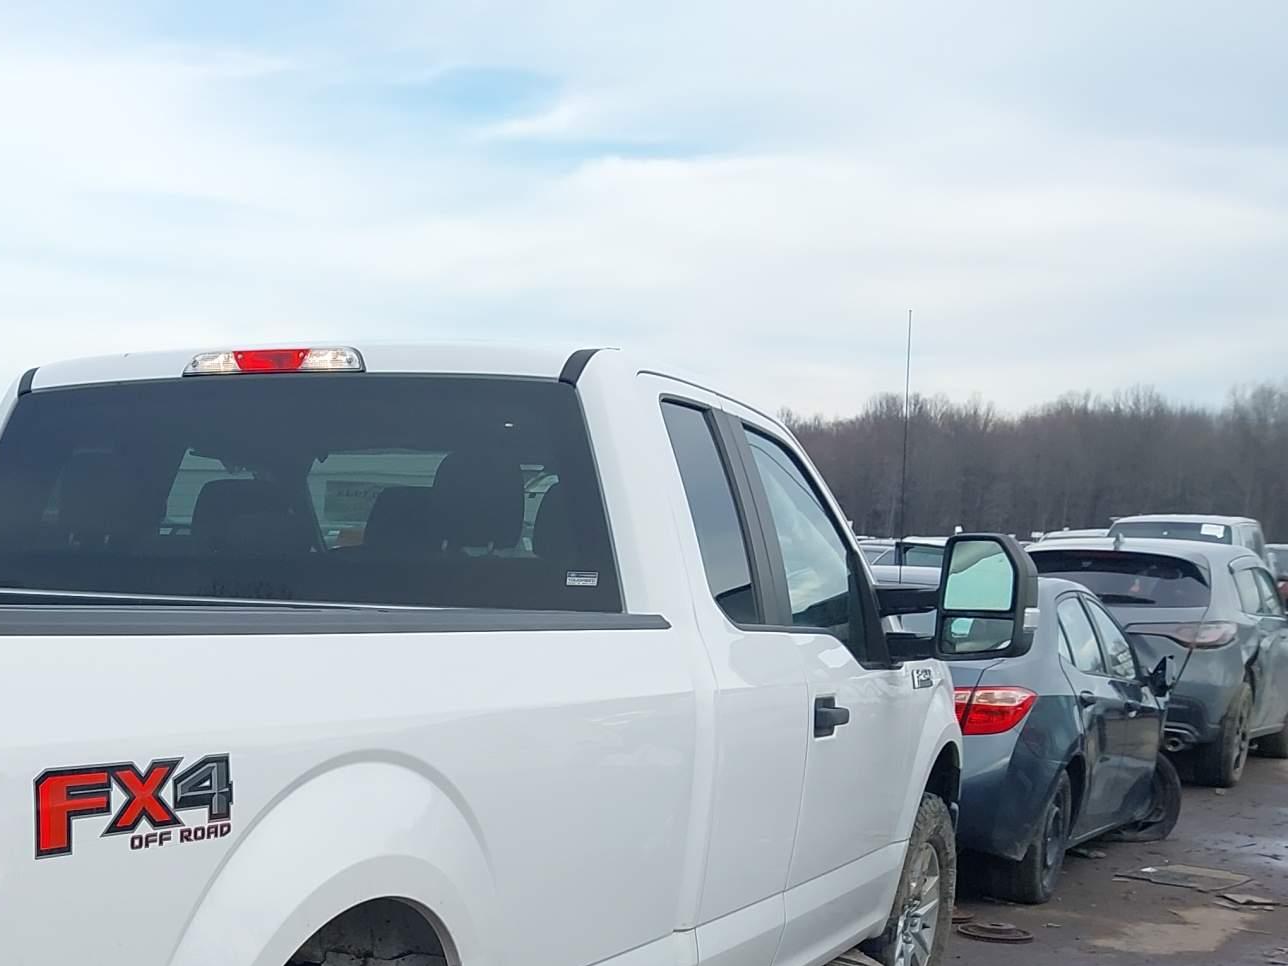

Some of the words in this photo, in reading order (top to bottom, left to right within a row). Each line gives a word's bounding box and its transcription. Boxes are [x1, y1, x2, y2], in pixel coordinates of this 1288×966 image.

[33, 753, 233, 859] FX4
[130, 831, 172, 850] OFF
[180, 823, 232, 844] ROAD
